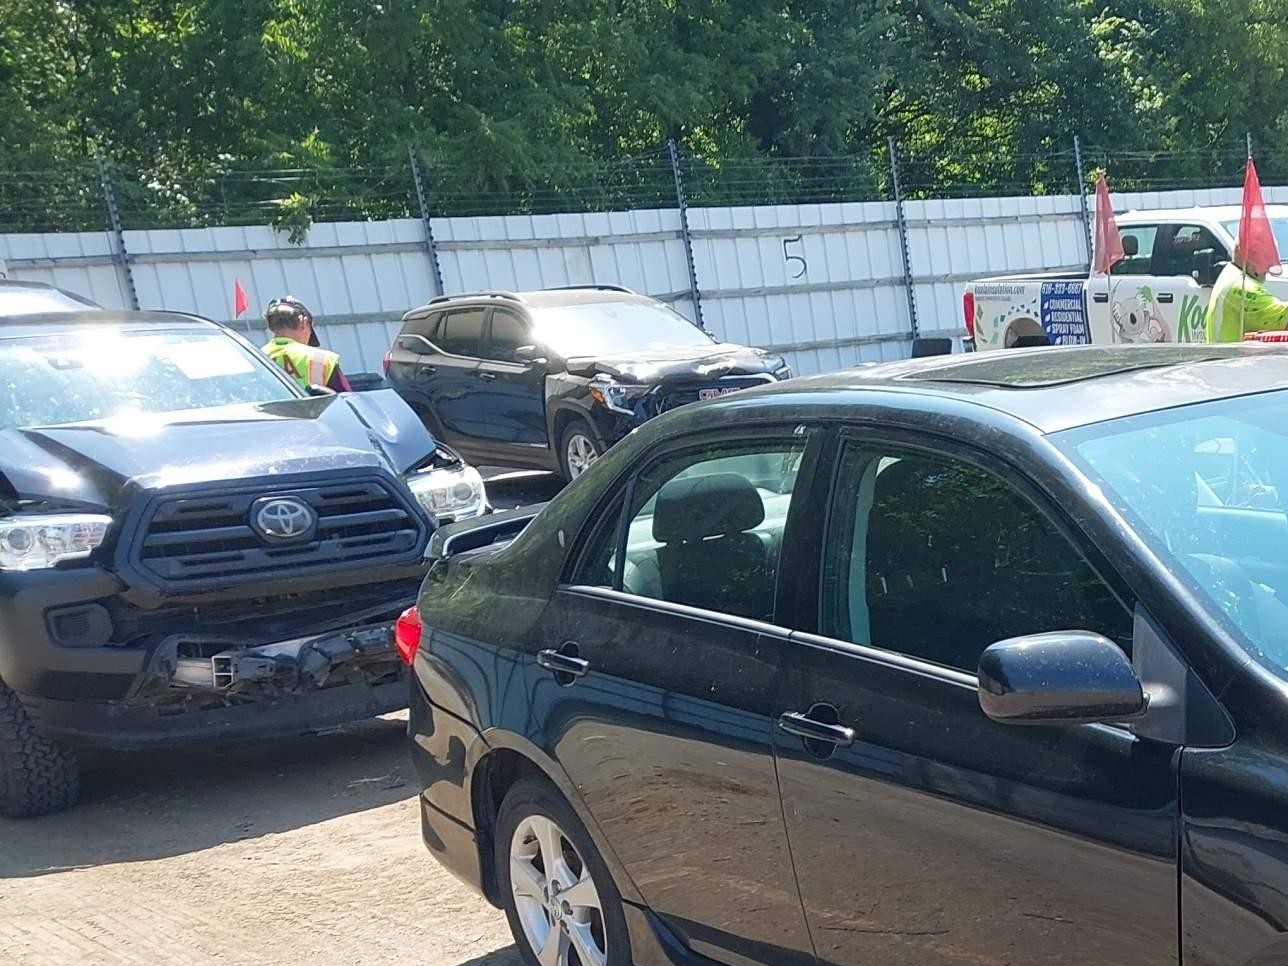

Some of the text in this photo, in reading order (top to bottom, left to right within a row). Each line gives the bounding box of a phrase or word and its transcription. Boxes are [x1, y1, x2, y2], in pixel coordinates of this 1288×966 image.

[783, 234, 807, 279] 5
[1049, 298, 1081, 310] COMMERCIAL
[1051, 311, 1083, 322] RESIDENTIAL
[1052, 323, 1069, 334] SPRAY
